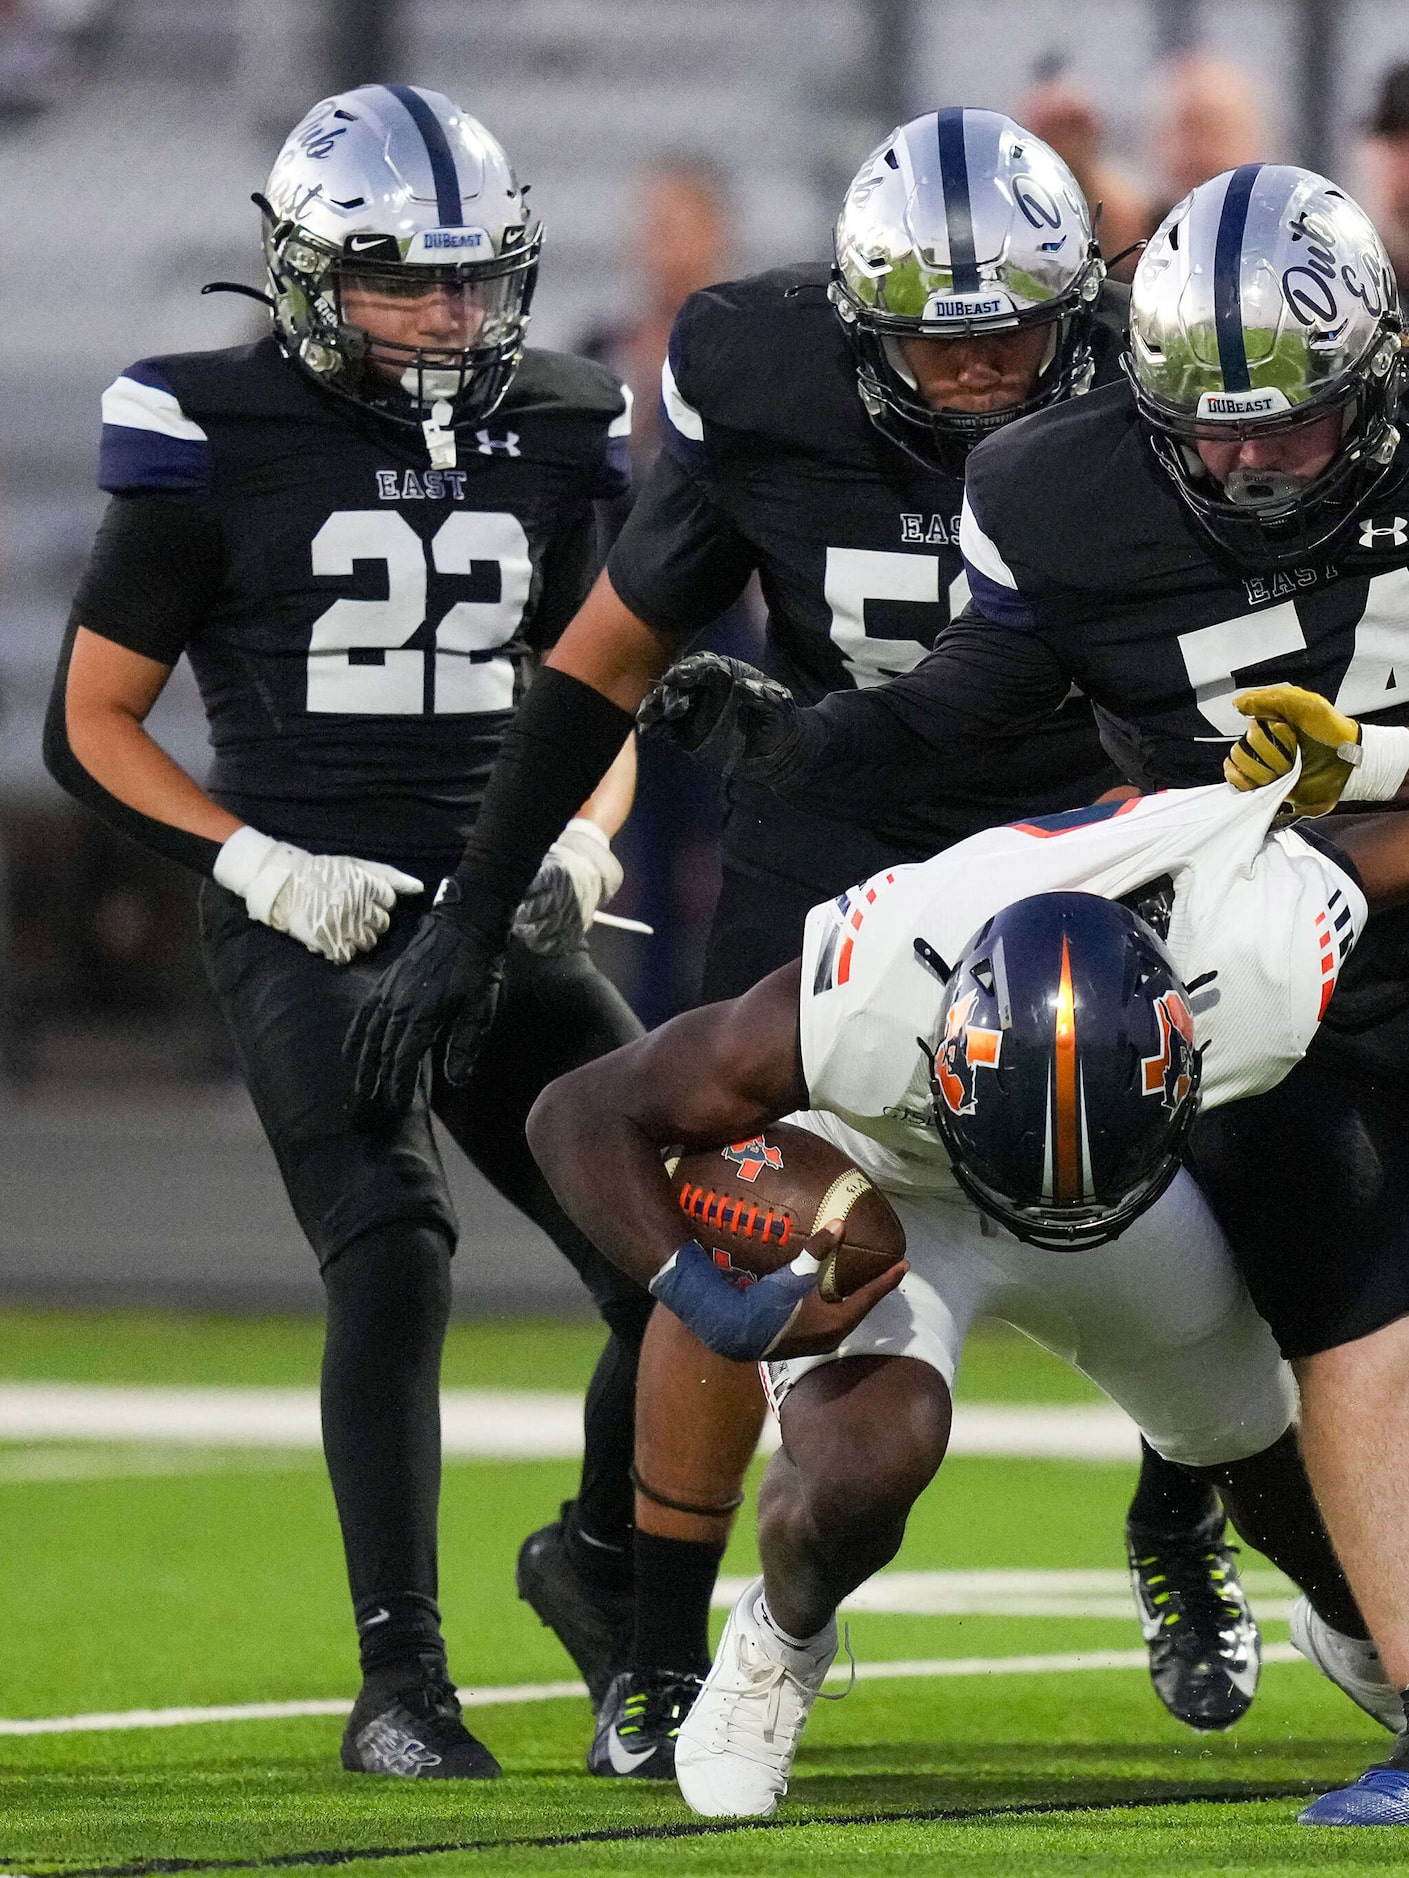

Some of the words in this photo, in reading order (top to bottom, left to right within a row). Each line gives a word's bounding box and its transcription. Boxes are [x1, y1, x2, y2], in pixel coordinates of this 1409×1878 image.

[936, 299, 1001, 318] DUBEAST
[1207, 397, 1274, 414] DUBEAST
[376, 469, 467, 500] EAST
[306, 509, 533, 714] 22
[824, 546, 974, 691] 5
